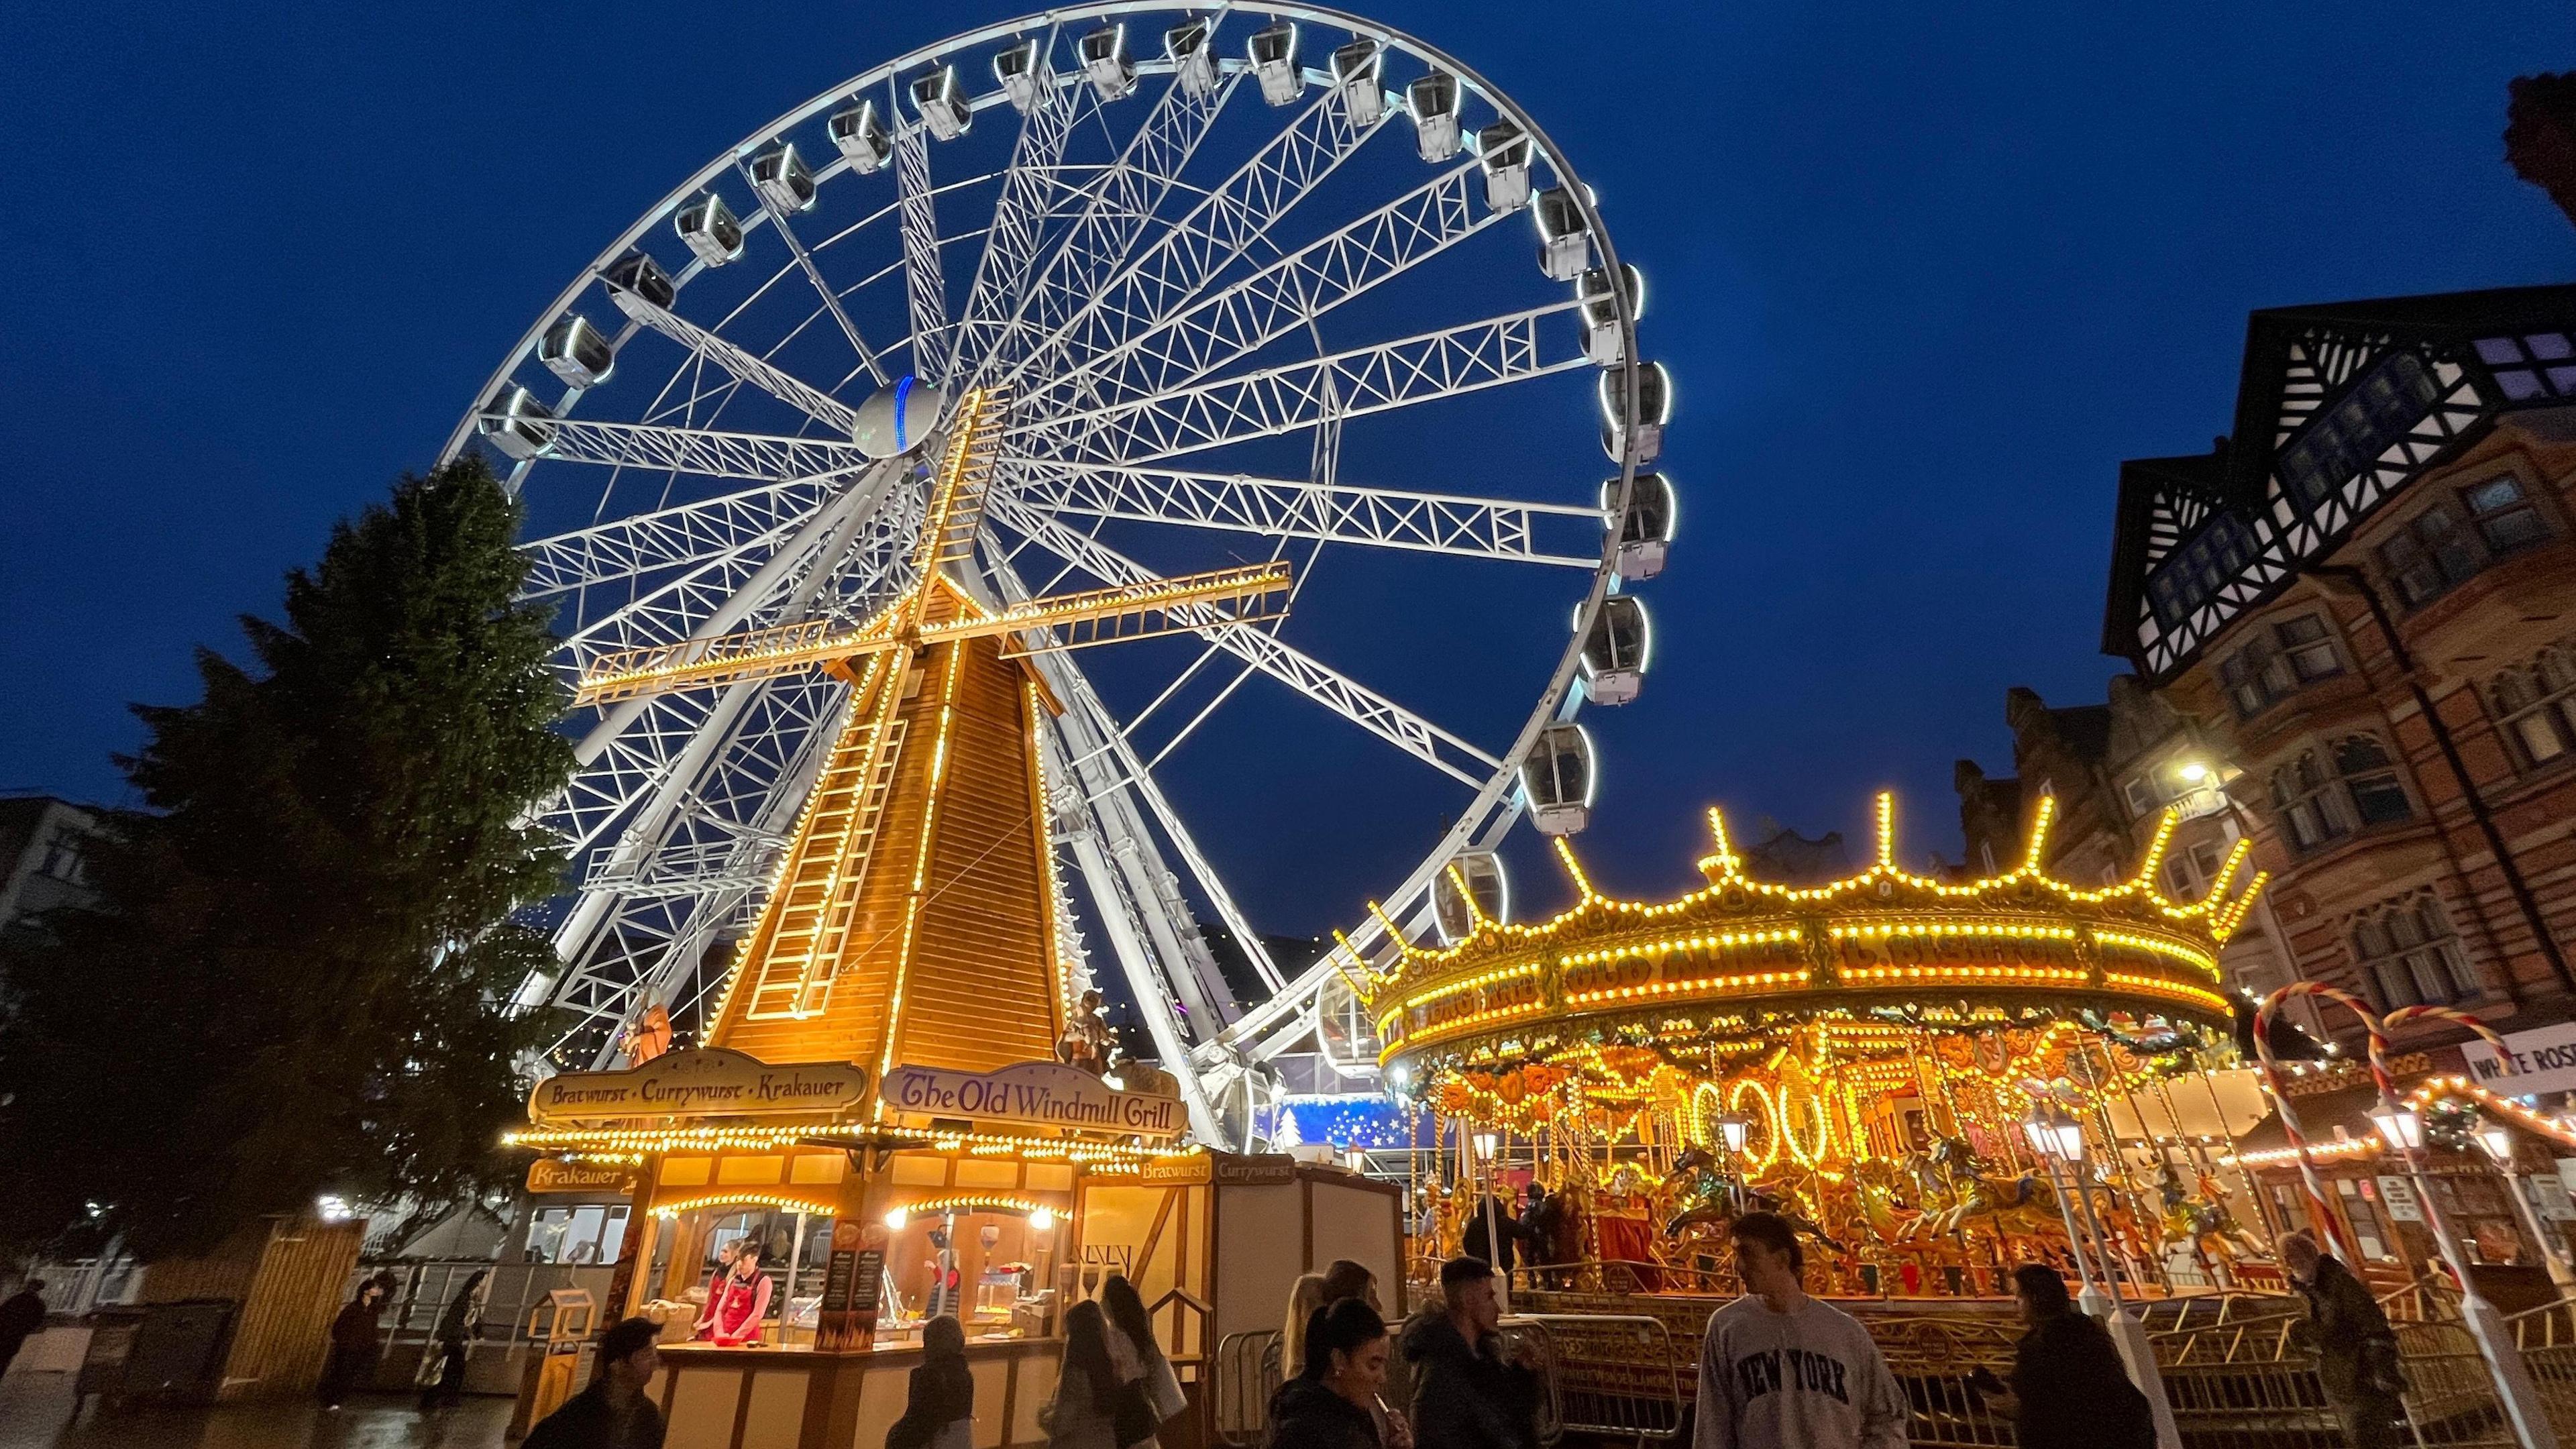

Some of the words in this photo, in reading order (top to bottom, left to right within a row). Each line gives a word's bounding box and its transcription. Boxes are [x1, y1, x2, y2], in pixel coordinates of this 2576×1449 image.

[1566, 955, 1652, 994] OLD
[552, 1085, 627, 1105] Bratwurst
[641, 1079, 745, 1107] Currywurst
[756, 1073, 845, 1100] Krakauer
[901, 1072, 955, 1108] The
[957, 1081, 1010, 1114] Old
[1014, 1084, 1122, 1124] Windmill
[1124, 1098, 1173, 1130] Grill
[534, 1166, 621, 1185] Krakauer
[1142, 1162, 1208, 1179] Bratwurst
[1218, 1162, 1291, 1180] Currywurst
[1737, 1349, 1782, 1402] NEW
[1786, 1348, 1849, 1405] YORK
